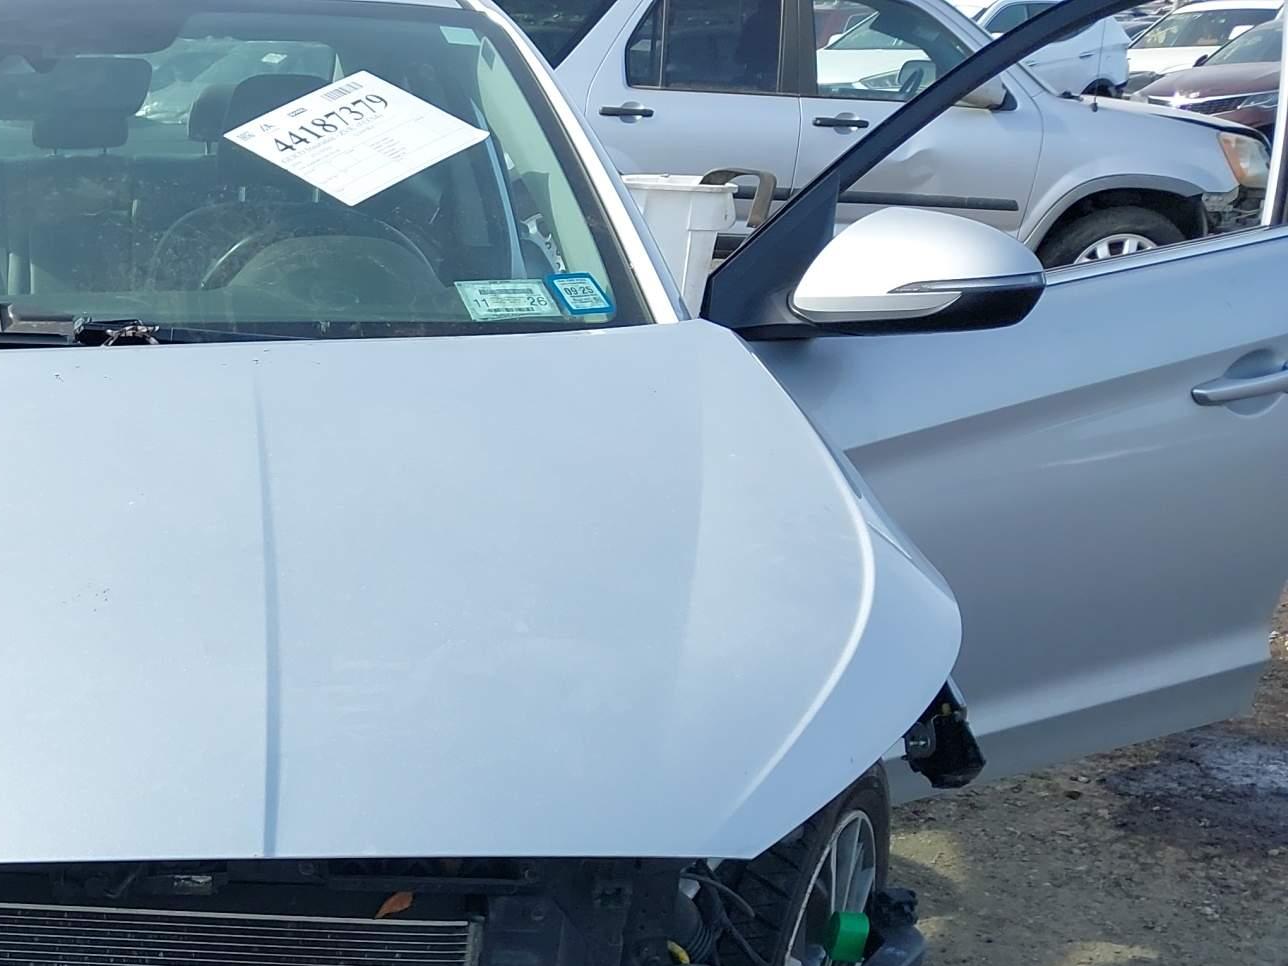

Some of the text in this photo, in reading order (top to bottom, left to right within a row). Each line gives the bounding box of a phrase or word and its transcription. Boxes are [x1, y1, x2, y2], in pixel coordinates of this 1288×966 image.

[274, 94, 388, 153] 44187379
[564, 286, 594, 296] 09 25
[473, 298, 489, 308] 11
[527, 296, 548, 307] 26
